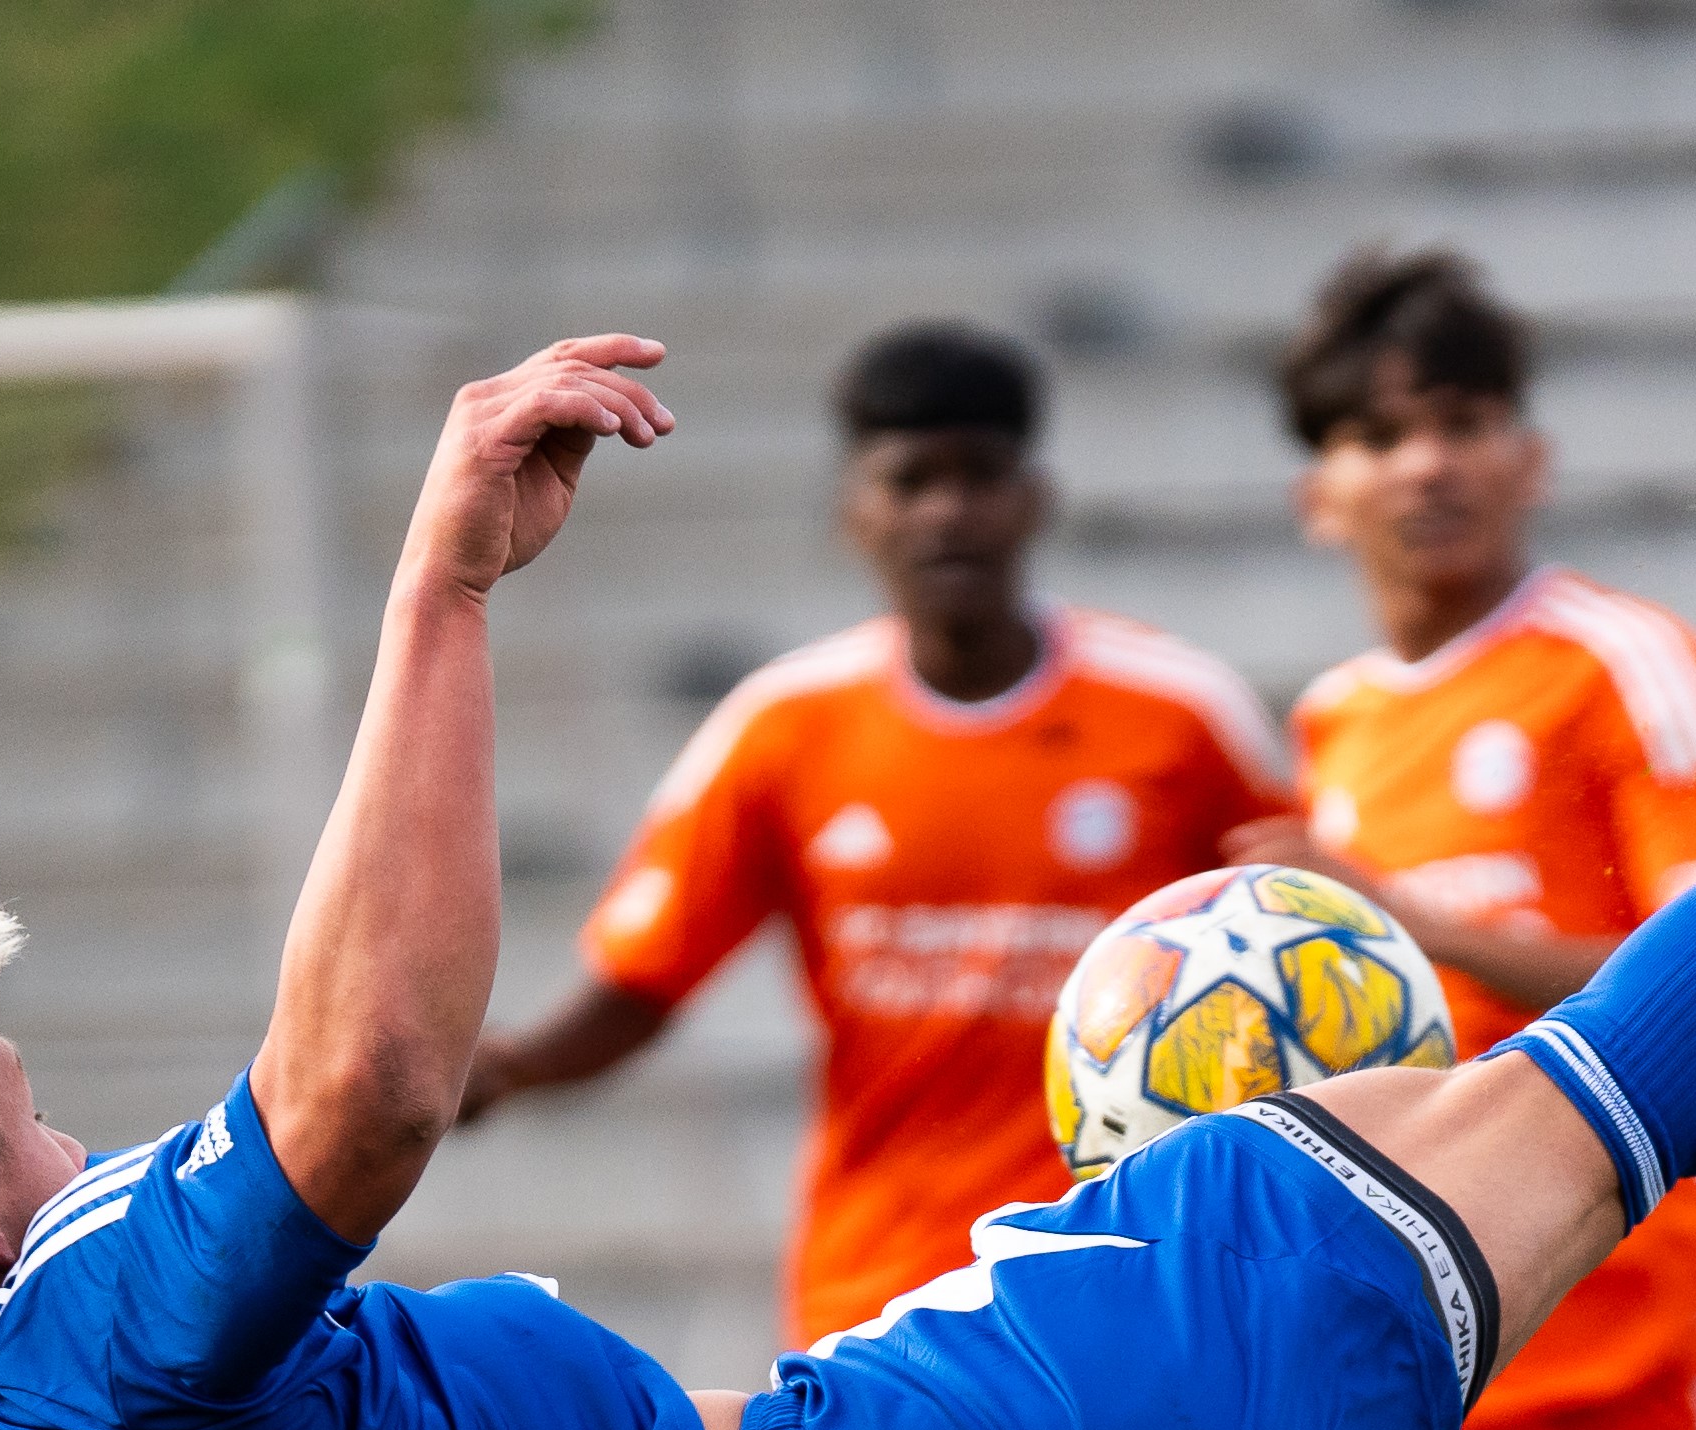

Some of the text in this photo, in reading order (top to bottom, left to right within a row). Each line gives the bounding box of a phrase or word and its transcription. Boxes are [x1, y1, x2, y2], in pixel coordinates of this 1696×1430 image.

[1259, 1107, 1471, 1392] THIKA ETHIKA ETHIKA
